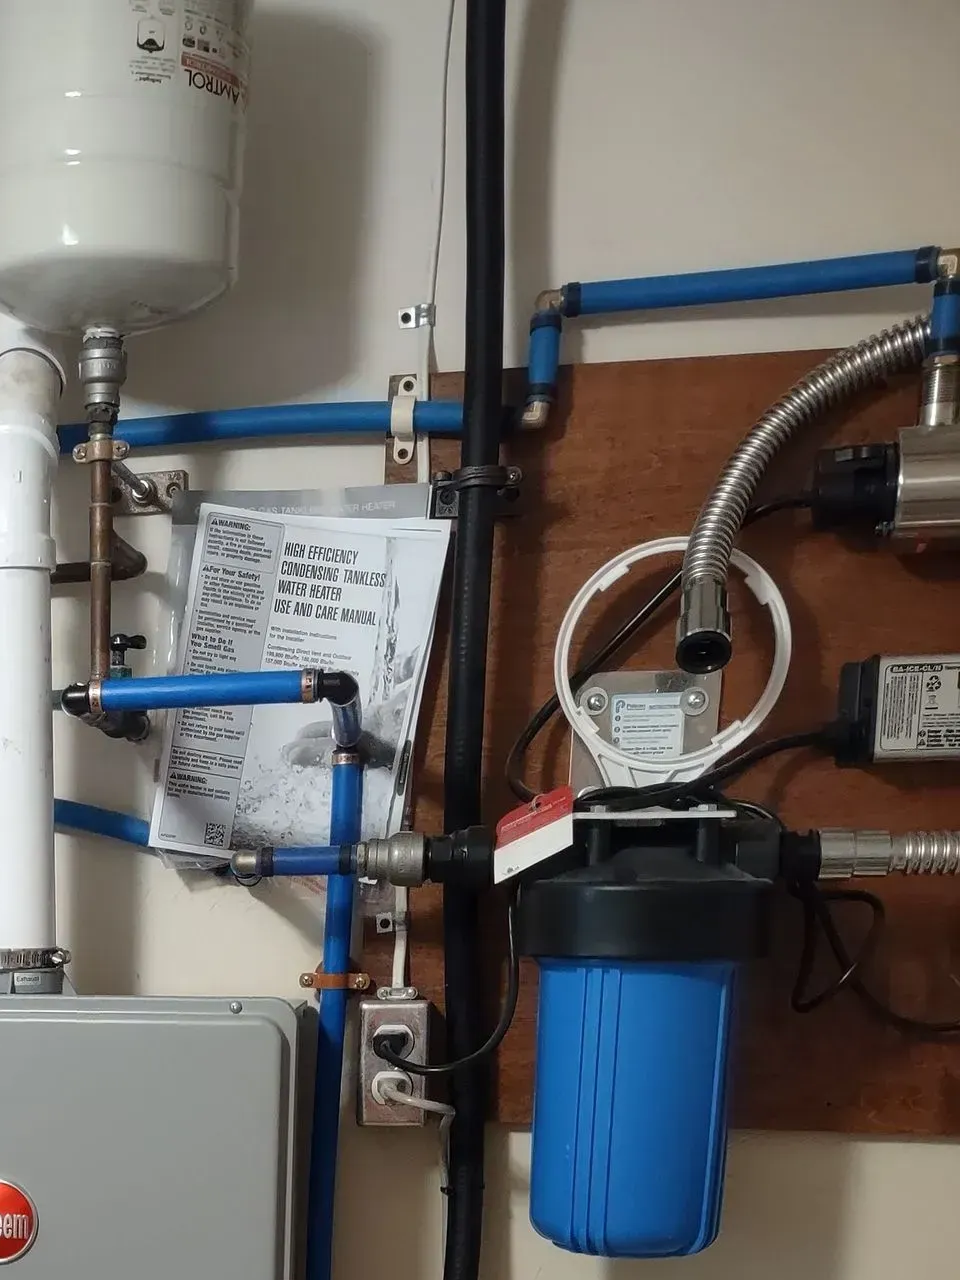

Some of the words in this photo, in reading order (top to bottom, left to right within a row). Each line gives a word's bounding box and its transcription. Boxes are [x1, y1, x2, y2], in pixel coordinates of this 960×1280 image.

[184, 69, 240, 104] AMTROL
[362, 500, 396, 512] HEATER
[218, 519, 251, 531] WARNING:
[284, 542, 306, 558] HIGH
[308, 545, 358, 565] EFFICIENCY
[222, 568, 236, 576] Your
[238, 570, 260, 582] Safety!
[281, 561, 339, 582] CONDENSING
[343, 569, 386, 588] TANKLESS
[278, 580, 306, 597] WATER
[309, 584, 342, 602] HEATER
[274, 599, 292, 614] USE
[293, 601, 313, 617] AND
[315, 603, 339, 621] CARE
[340, 608, 376, 626] MANUAL
[192, 633, 208, 642] What
[204, 642, 221, 651] Smell
